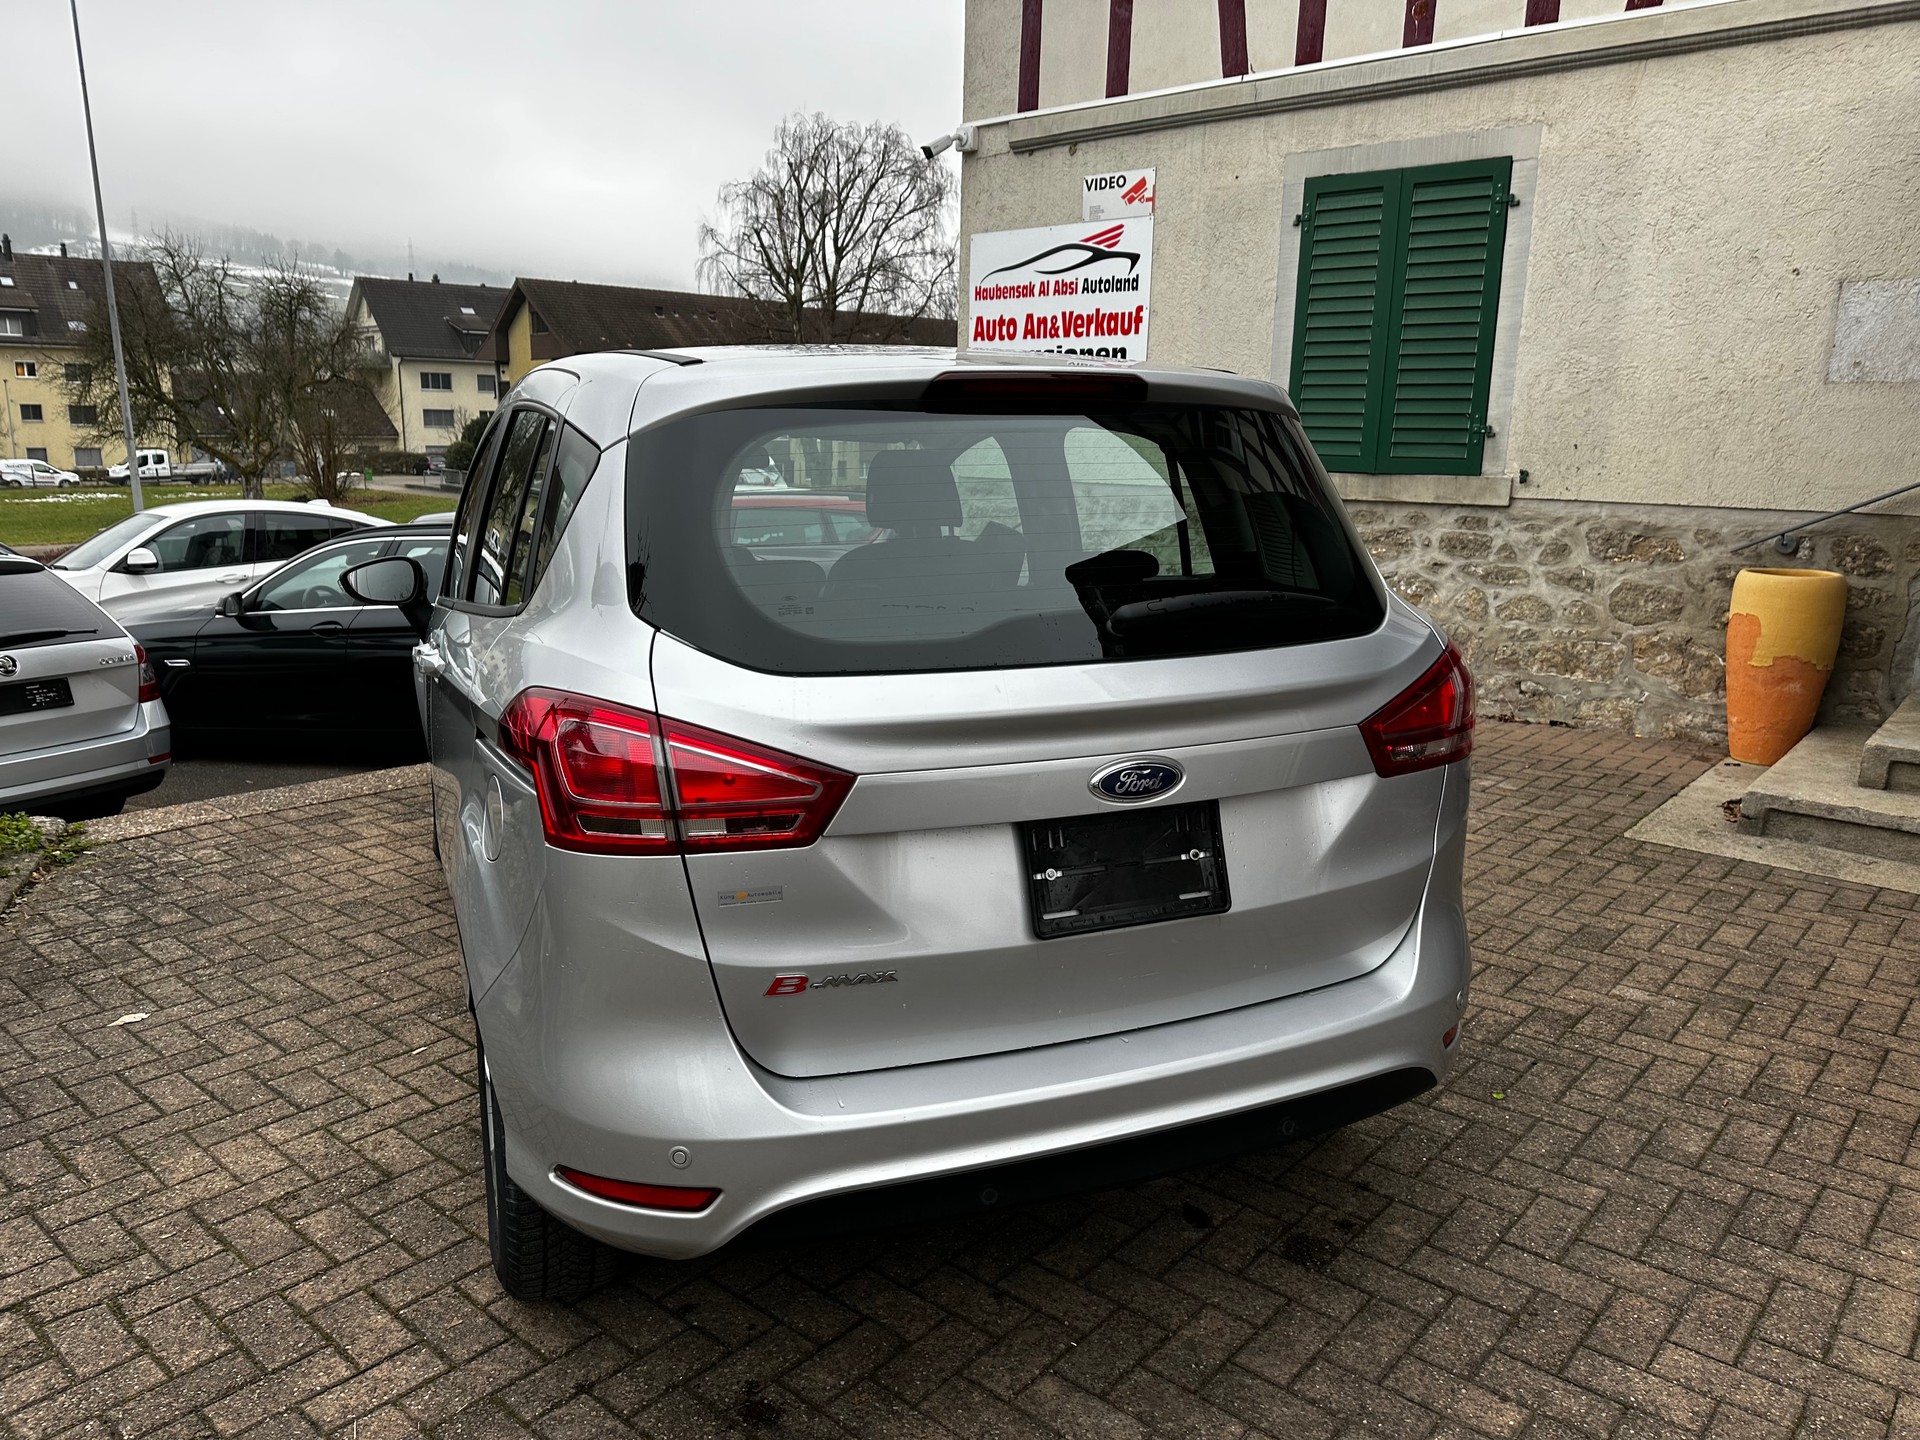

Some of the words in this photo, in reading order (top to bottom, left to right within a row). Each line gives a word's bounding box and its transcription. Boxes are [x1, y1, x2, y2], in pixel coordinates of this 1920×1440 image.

[1084, 174, 1127, 192] VIDEO
[974, 281, 1036, 301] Haubensak
[1053, 277, 1079, 296] Absi
[1081, 273, 1139, 295] Autoland
[973, 313, 1018, 342] Auto
[1022, 305, 1144, 340] An&Verkauf
[1115, 769, 1164, 794] Ford
[763, 970, 898, 997] B-MAX
